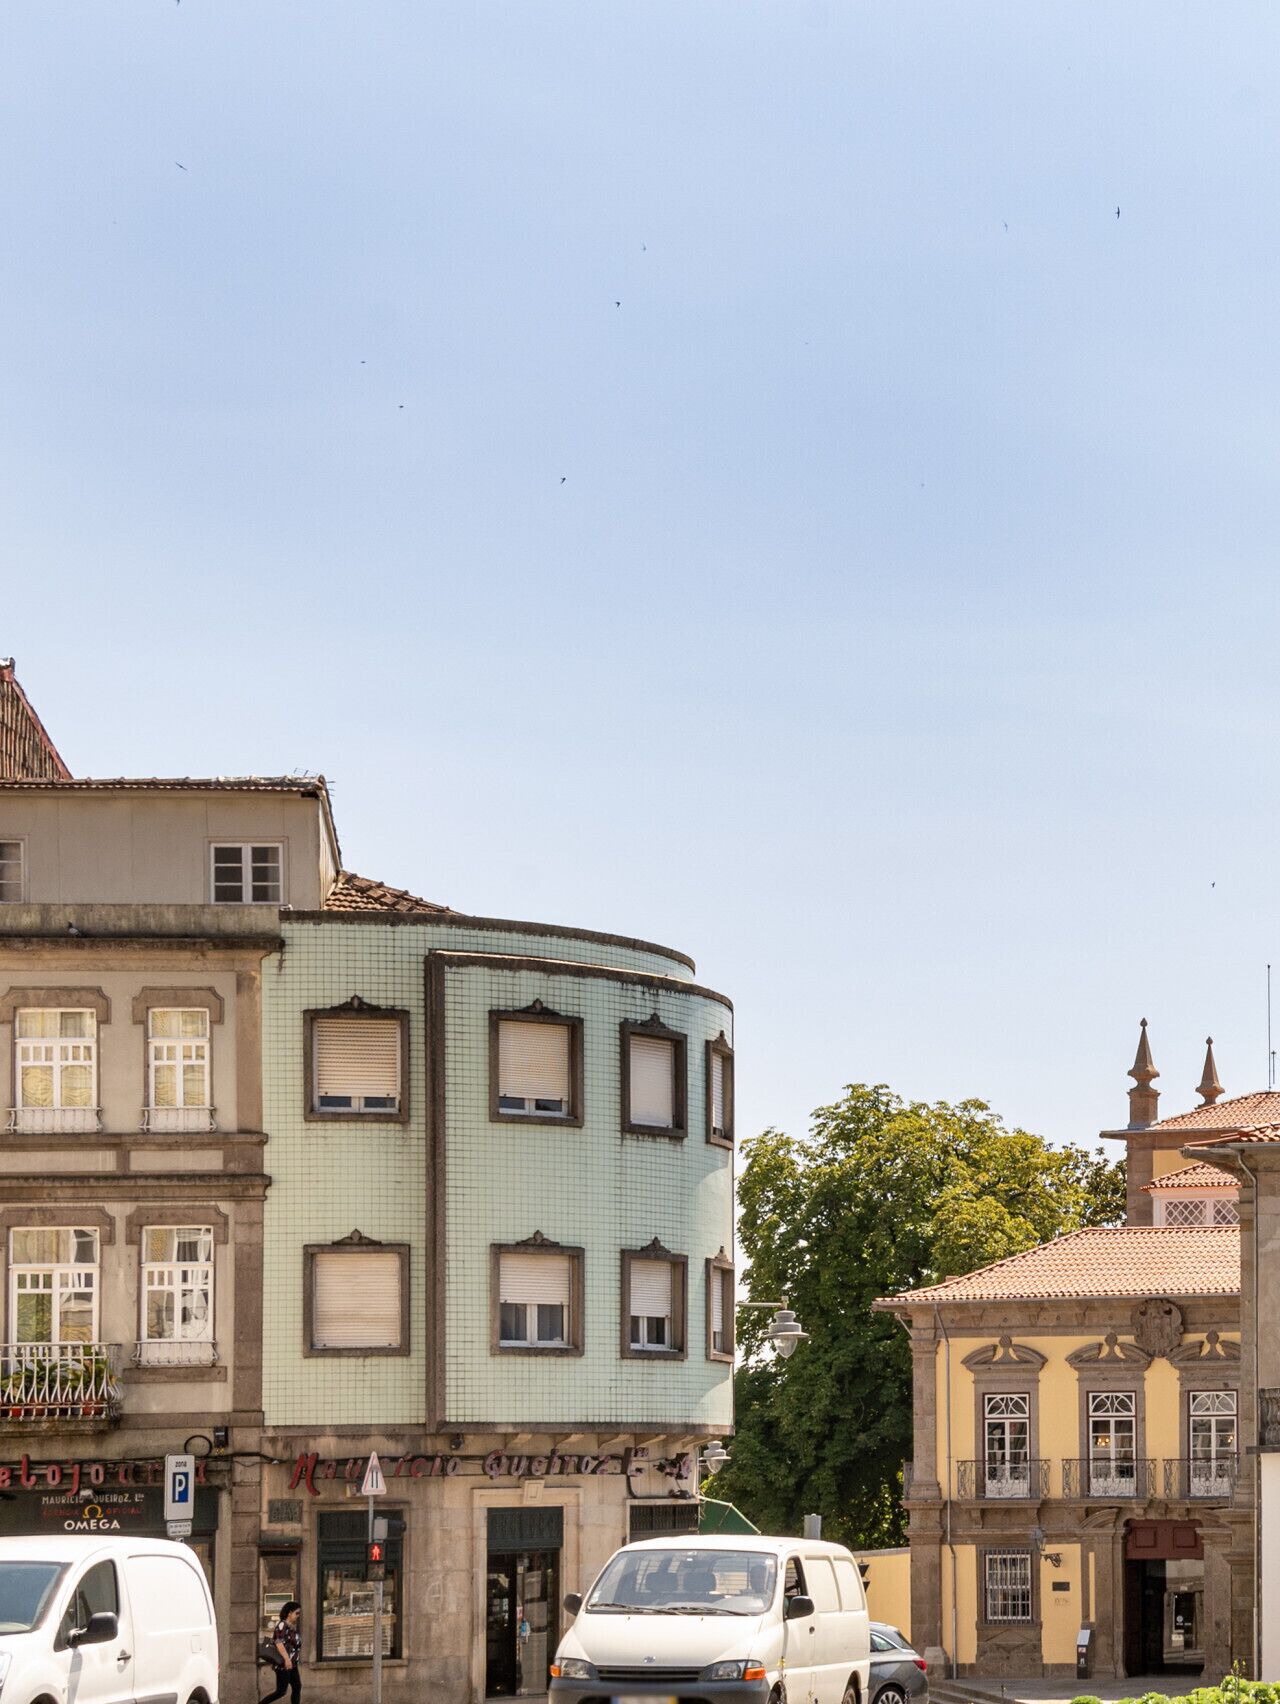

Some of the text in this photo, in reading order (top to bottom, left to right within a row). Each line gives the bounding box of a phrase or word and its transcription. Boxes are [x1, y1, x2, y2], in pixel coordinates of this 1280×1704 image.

[288, 1451, 462, 1496] Mauício
[175, 1474, 185, 1501] P
[64, 1518, 121, 1531] OMEGA
